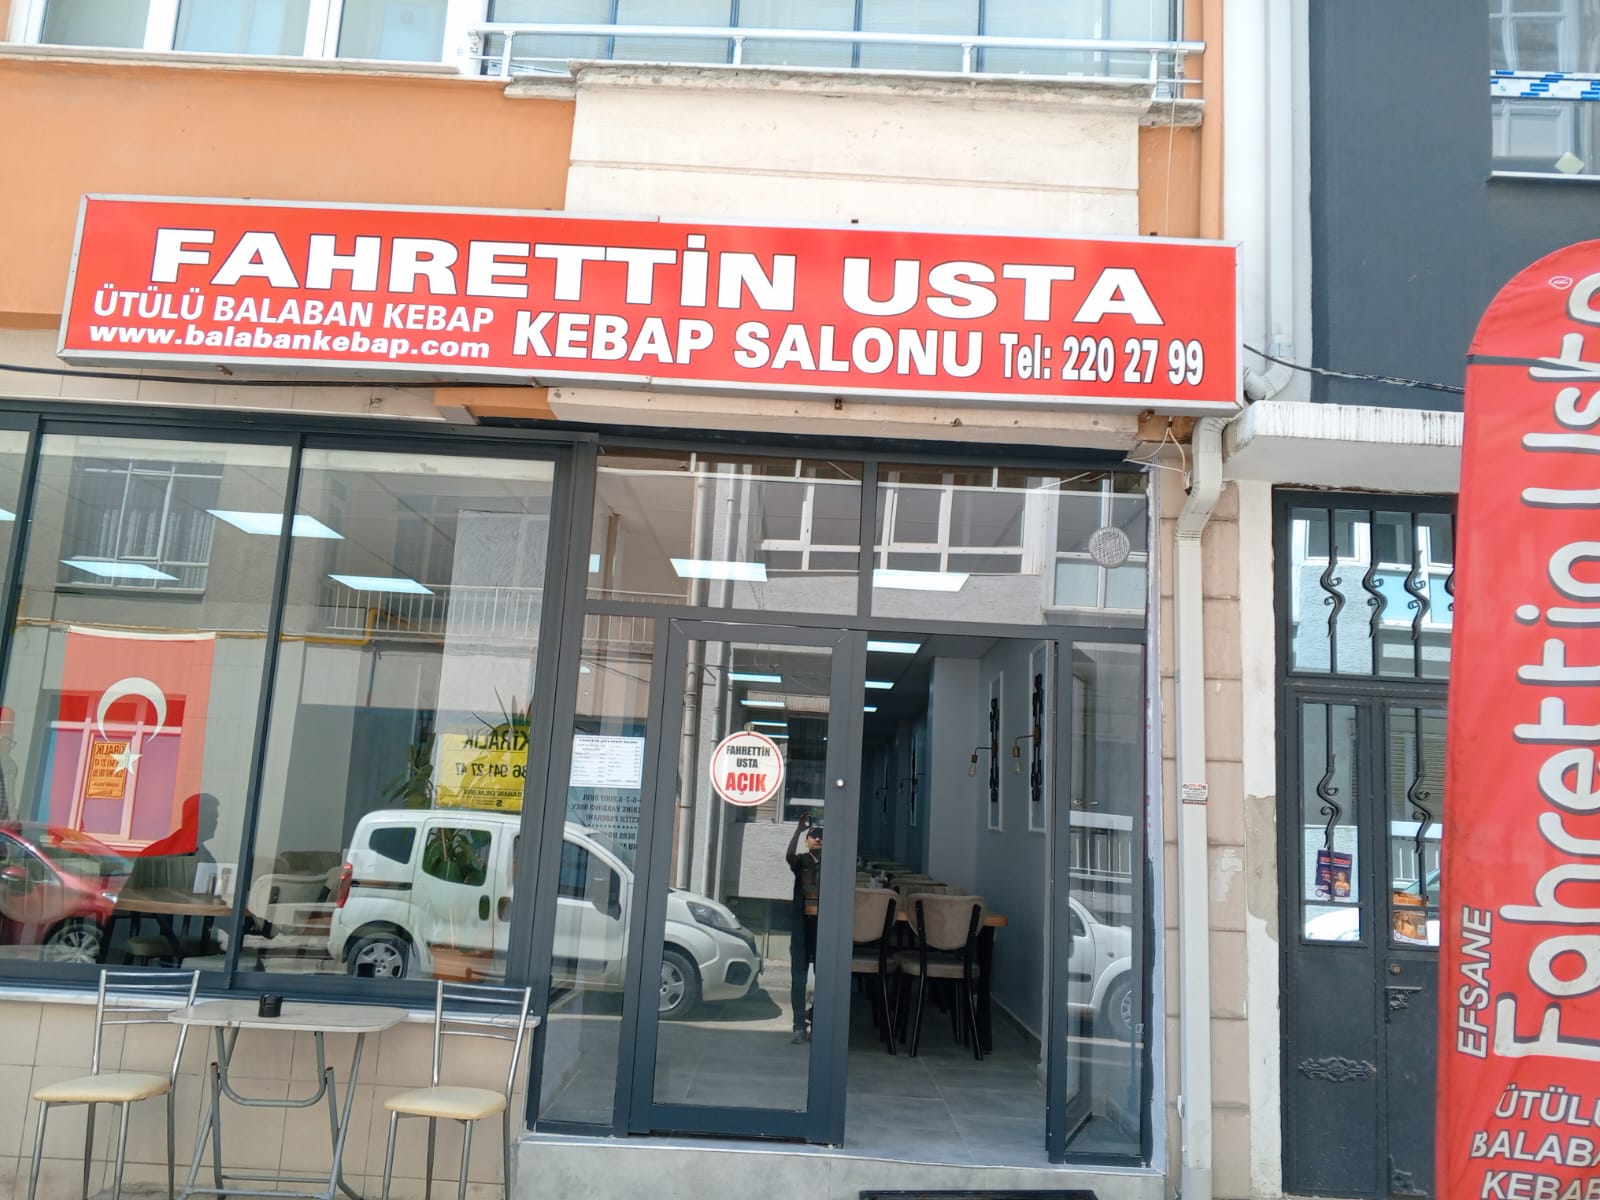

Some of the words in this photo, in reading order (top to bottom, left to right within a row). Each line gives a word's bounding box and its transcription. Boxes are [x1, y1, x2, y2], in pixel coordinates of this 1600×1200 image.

[149, 227, 797, 312] FAHRETTİN
[841, 256, 1165, 326] USTA
[93, 282, 204, 321] ÜTÜLÜ
[213, 296, 373, 328] BALABAN
[383, 302, 494, 333] KEBAP
[88, 323, 490, 359] www.balabankebap.com
[511, 309, 715, 365] KEBAP
[732, 320, 984, 378] SALONU
[998, 332, 1052, 381] Tel:
[1060, 335, 1116, 383] 220
[1122, 337, 1158, 385] 27
[1167, 338, 1205, 387] 99
[726, 745, 770, 757] FAHRETTİN
[736, 758, 759, 768] USTA
[725, 772, 767, 795] AÇIK
[1456, 905, 1492, 1059] EFSANE
[1495, 1082, 1600, 1128] ÜTÜL
[1470, 1128, 1600, 1167] BALAB
